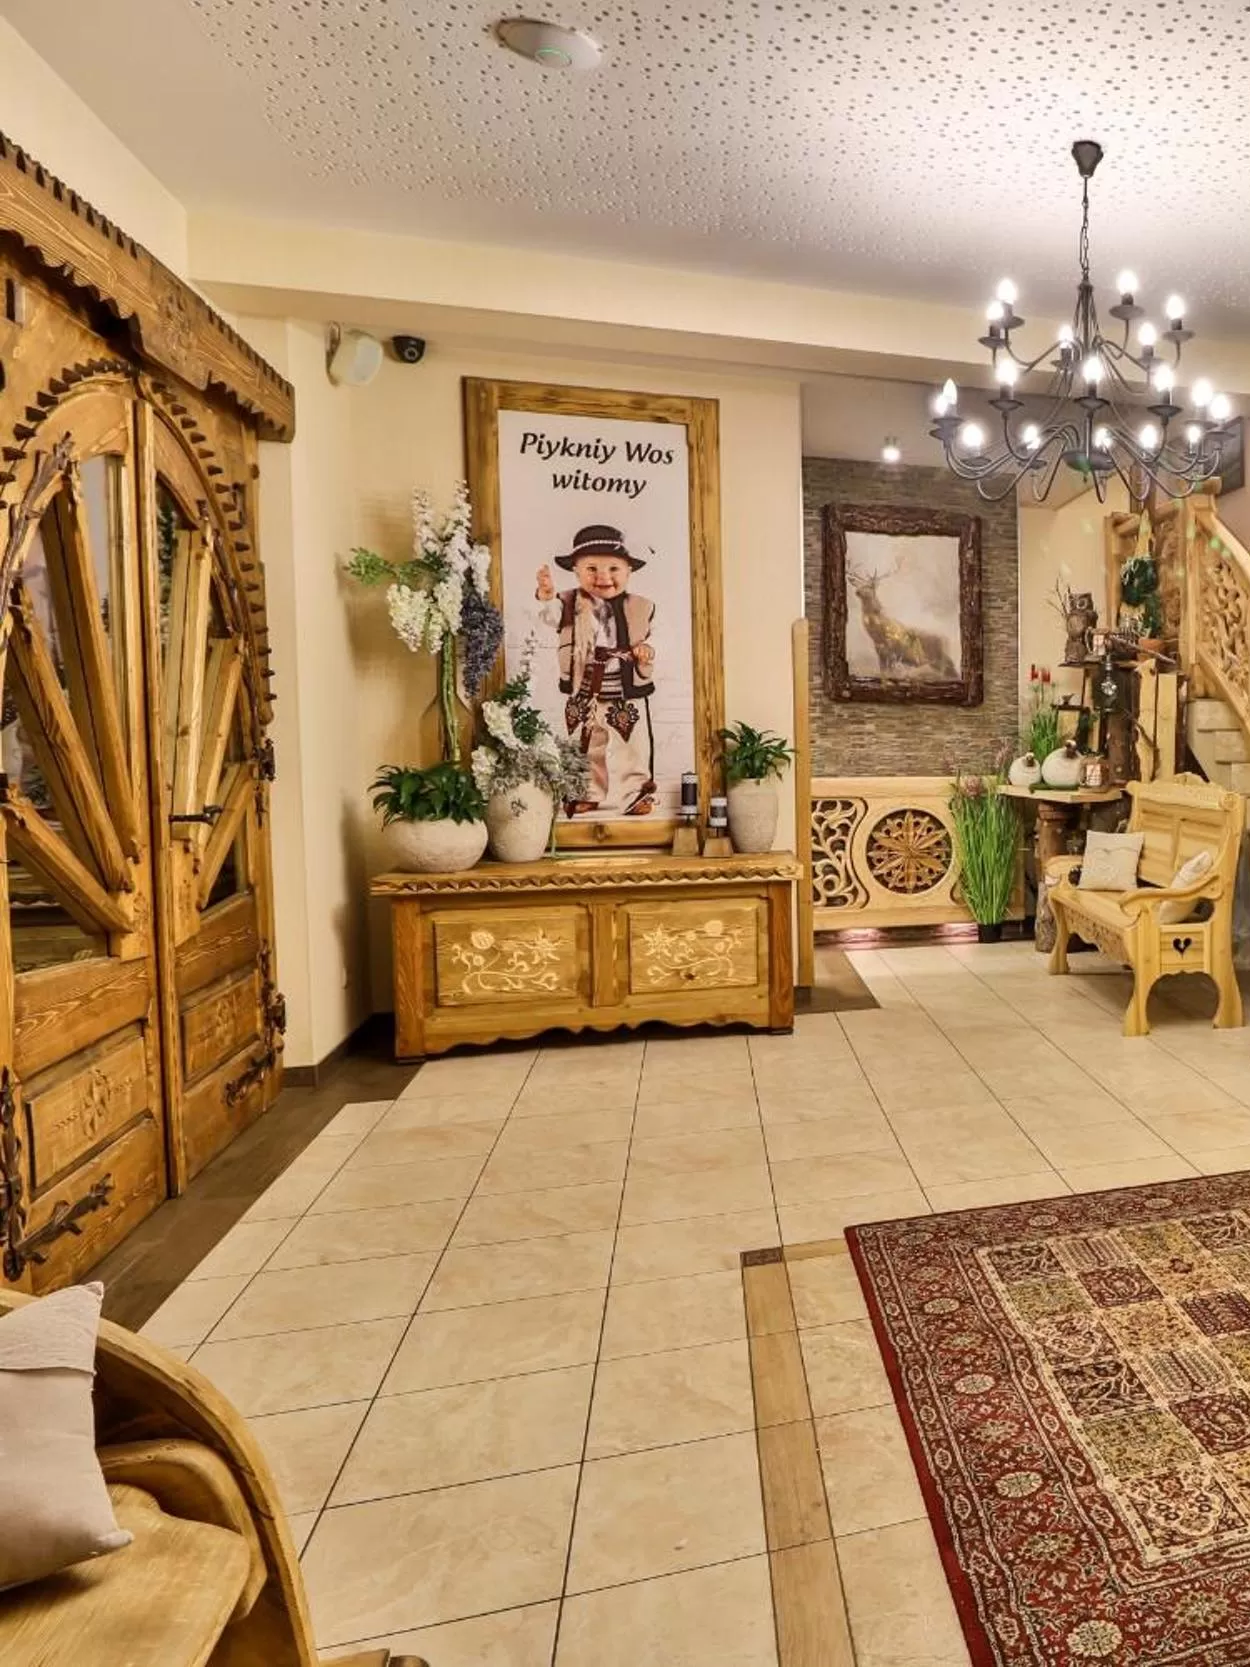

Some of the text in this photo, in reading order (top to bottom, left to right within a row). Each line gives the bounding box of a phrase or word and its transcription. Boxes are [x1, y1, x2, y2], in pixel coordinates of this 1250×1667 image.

[520, 432, 674, 464] Piykniy Wos
[552, 469, 647, 499] witomy
